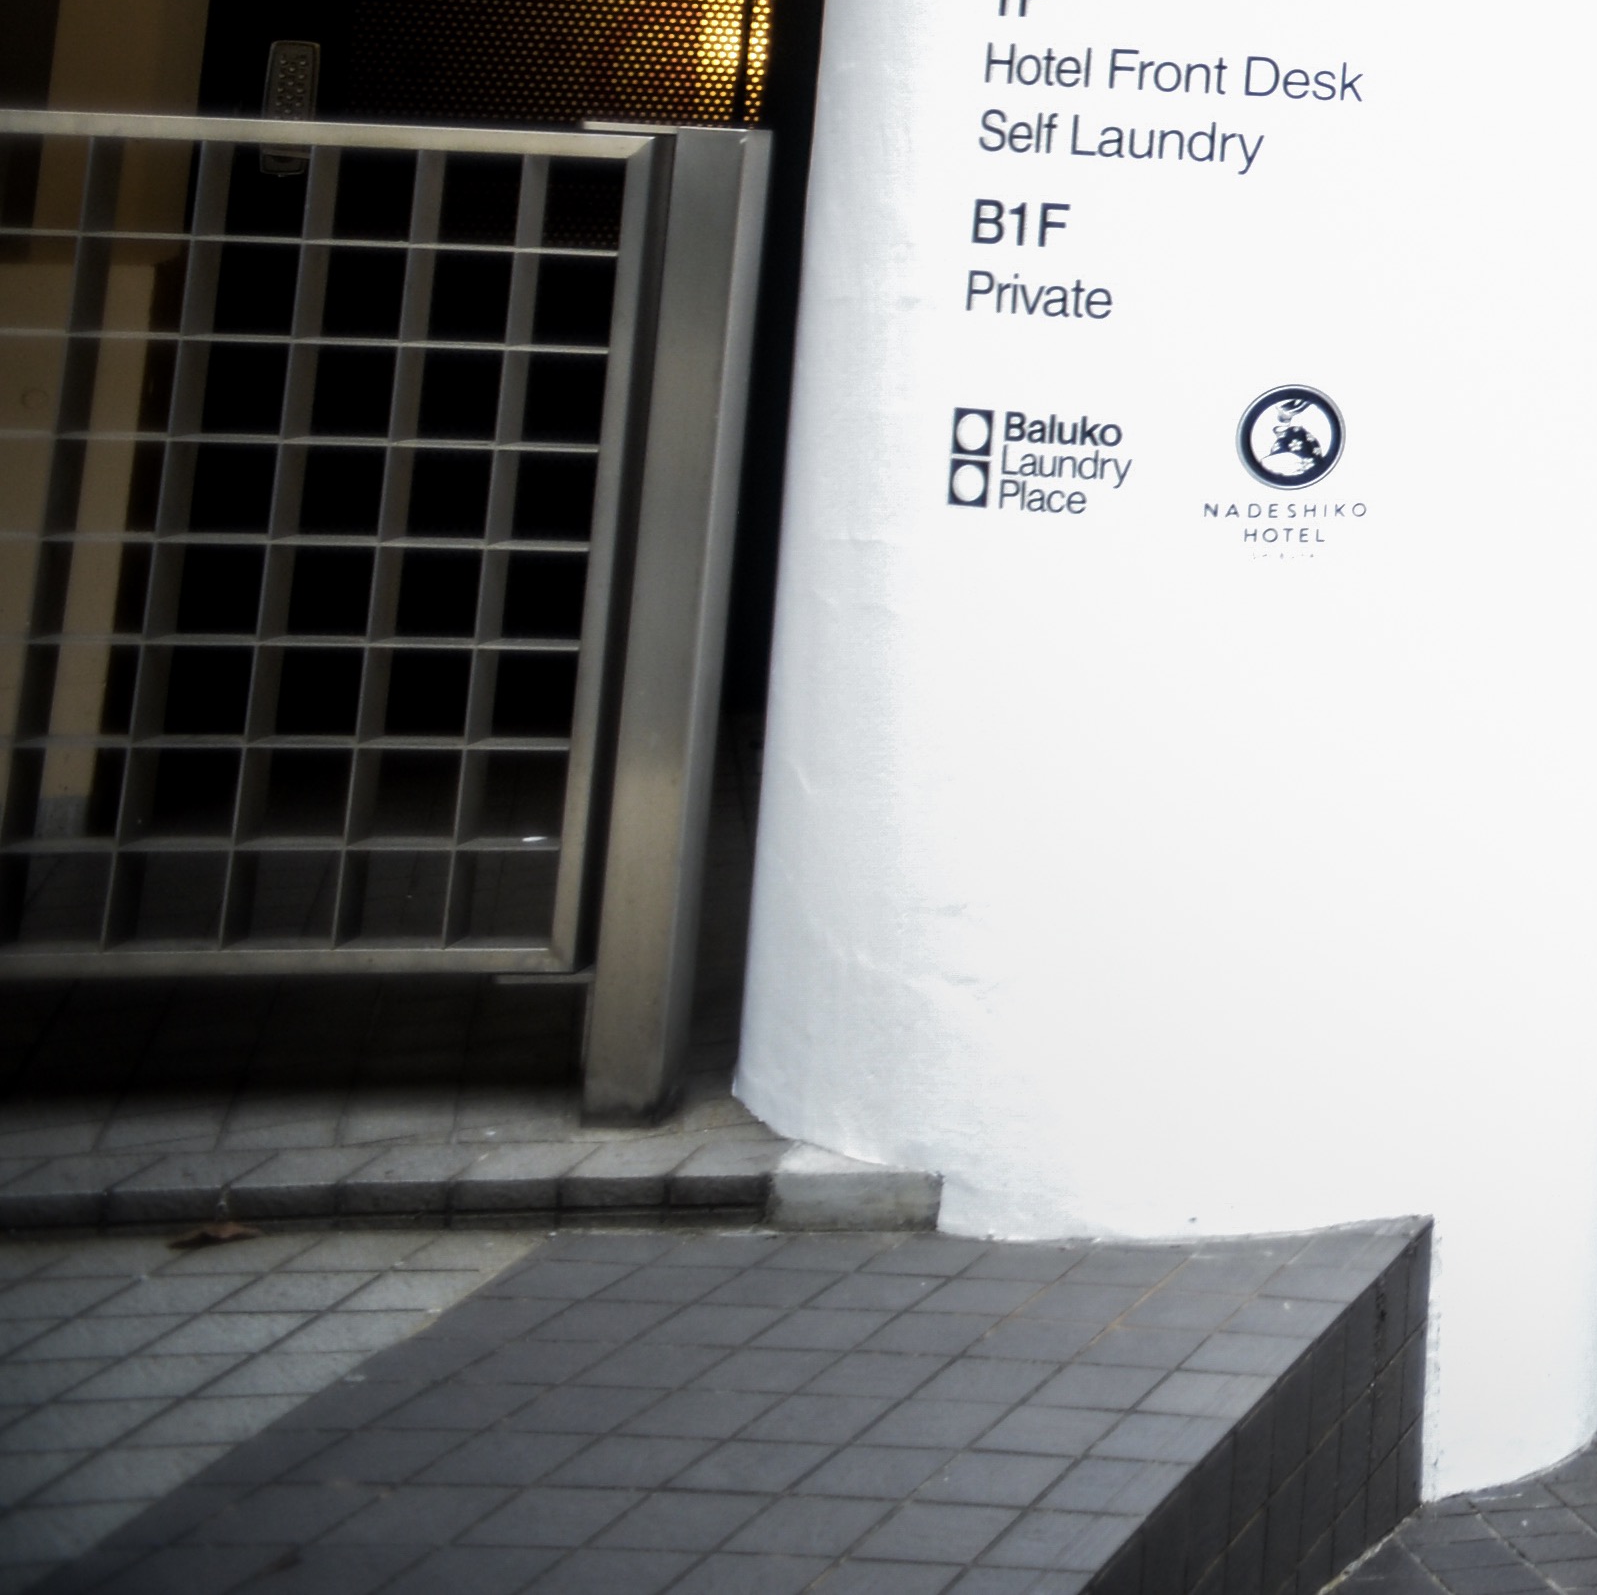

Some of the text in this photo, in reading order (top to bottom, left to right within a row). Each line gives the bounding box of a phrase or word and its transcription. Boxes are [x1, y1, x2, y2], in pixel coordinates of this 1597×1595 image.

[984, 42, 1364, 103] Hotel Front Desk
[978, 108, 1265, 175] Self Laundry
[971, 199, 1071, 248] B1F
[965, 269, 1113, 320] Private
[1002, 410, 1123, 447] Baluko
[999, 443, 1133, 489] Laundry
[997, 479, 1089, 515] Place
[1203, 502, 1368, 519] NADESHIKO
[1243, 527, 1326, 543] HOTEL
